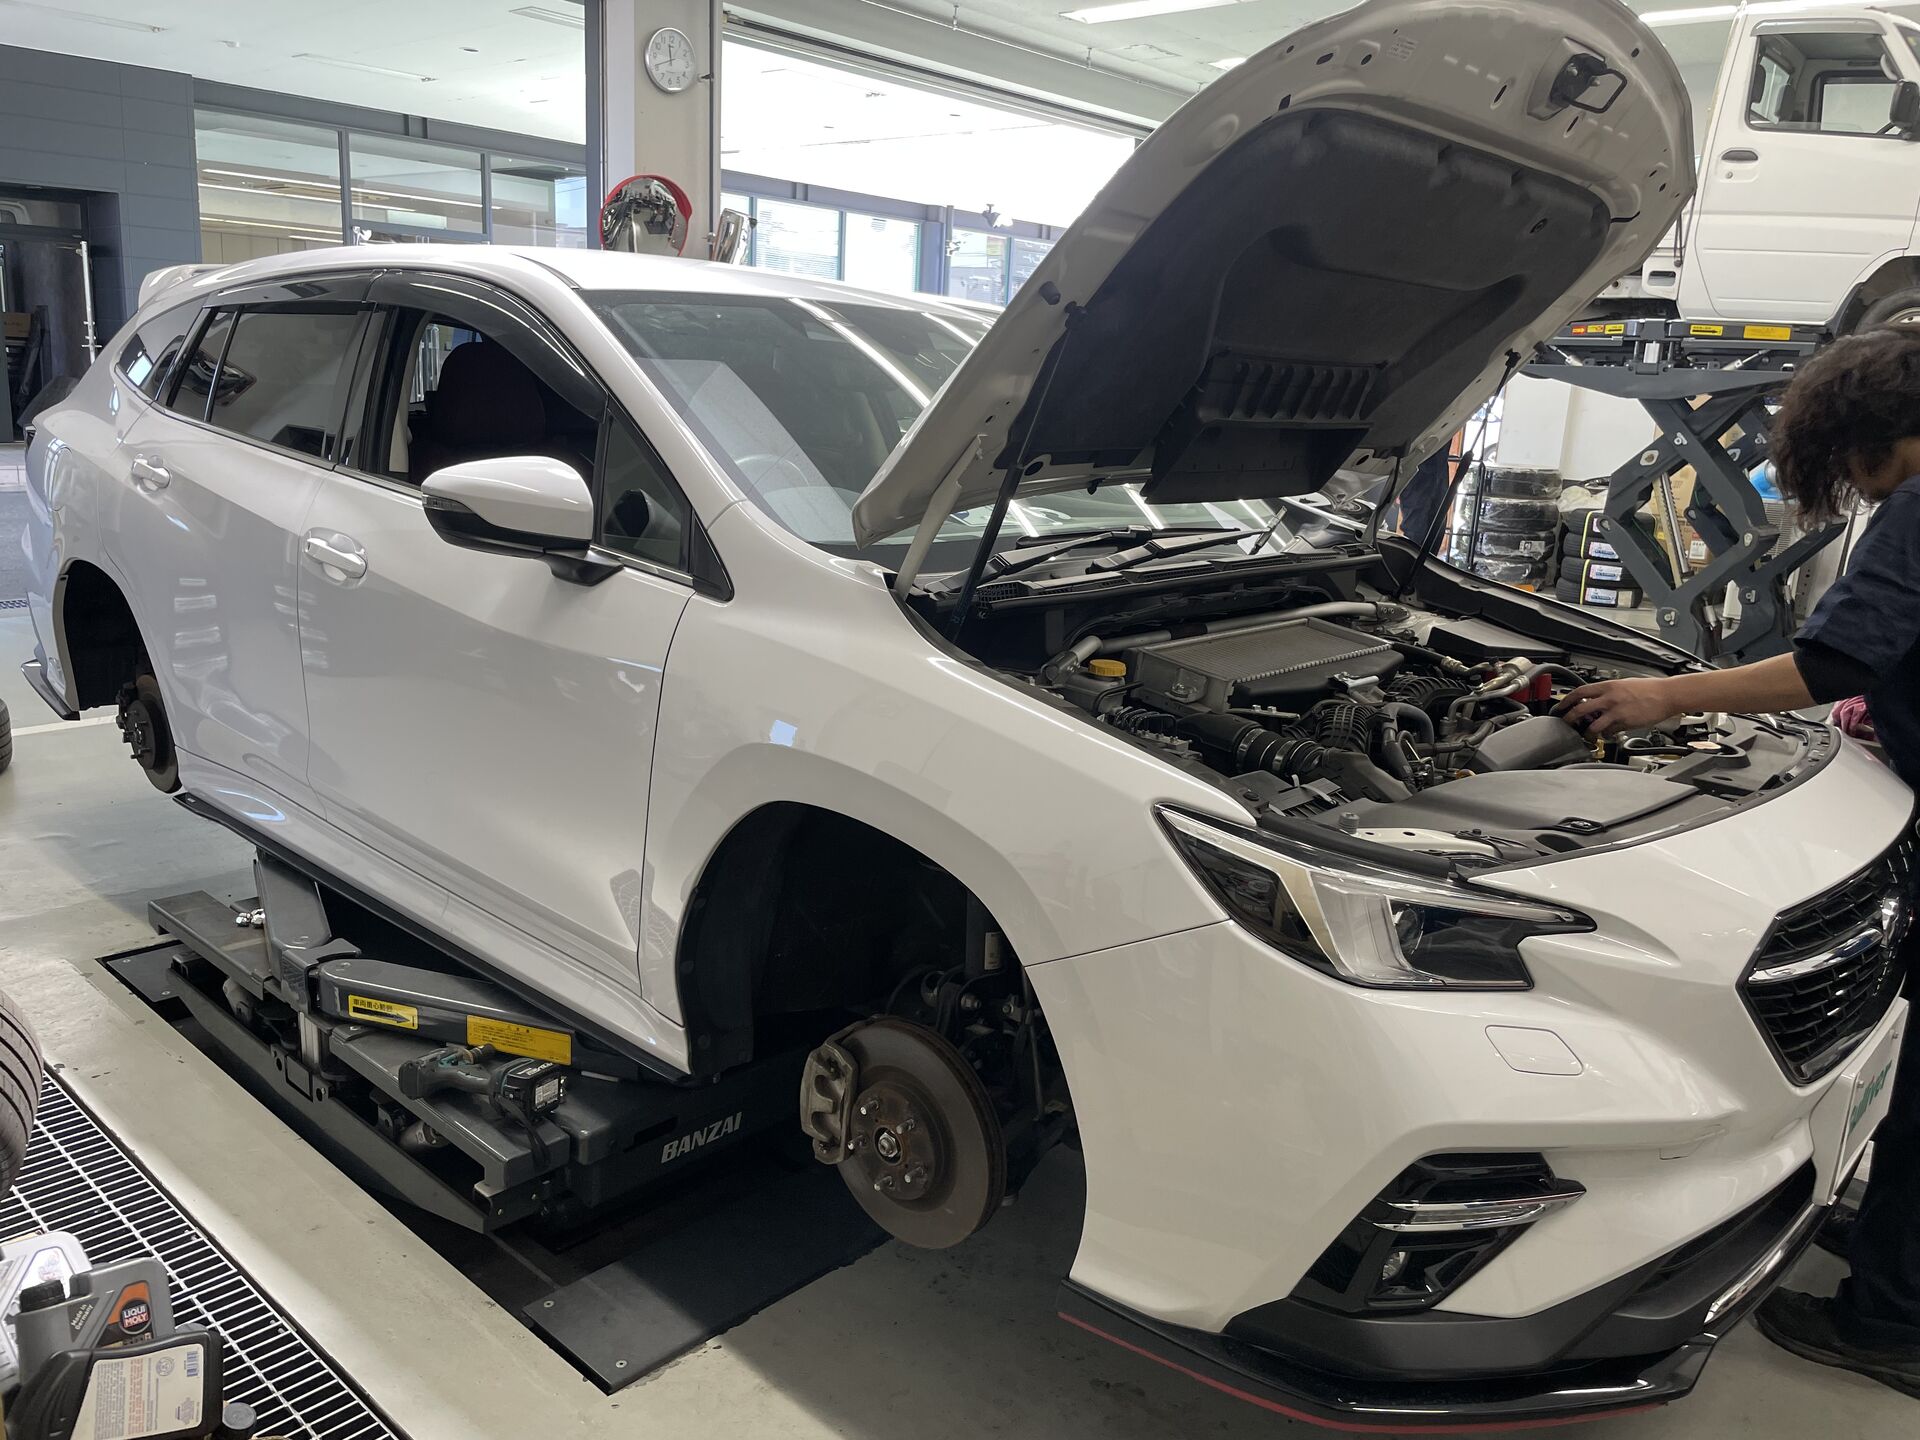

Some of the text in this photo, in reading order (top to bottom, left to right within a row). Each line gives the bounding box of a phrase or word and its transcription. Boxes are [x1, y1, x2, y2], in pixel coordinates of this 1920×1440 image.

[661, 1111, 742, 1164] BANZAI
[71, 1311, 82, 1326] Made
[75, 1304, 93, 1330] Germany
[123, 1304, 147, 1318] LIQUI
[124, 1312, 149, 1328] MOLY
